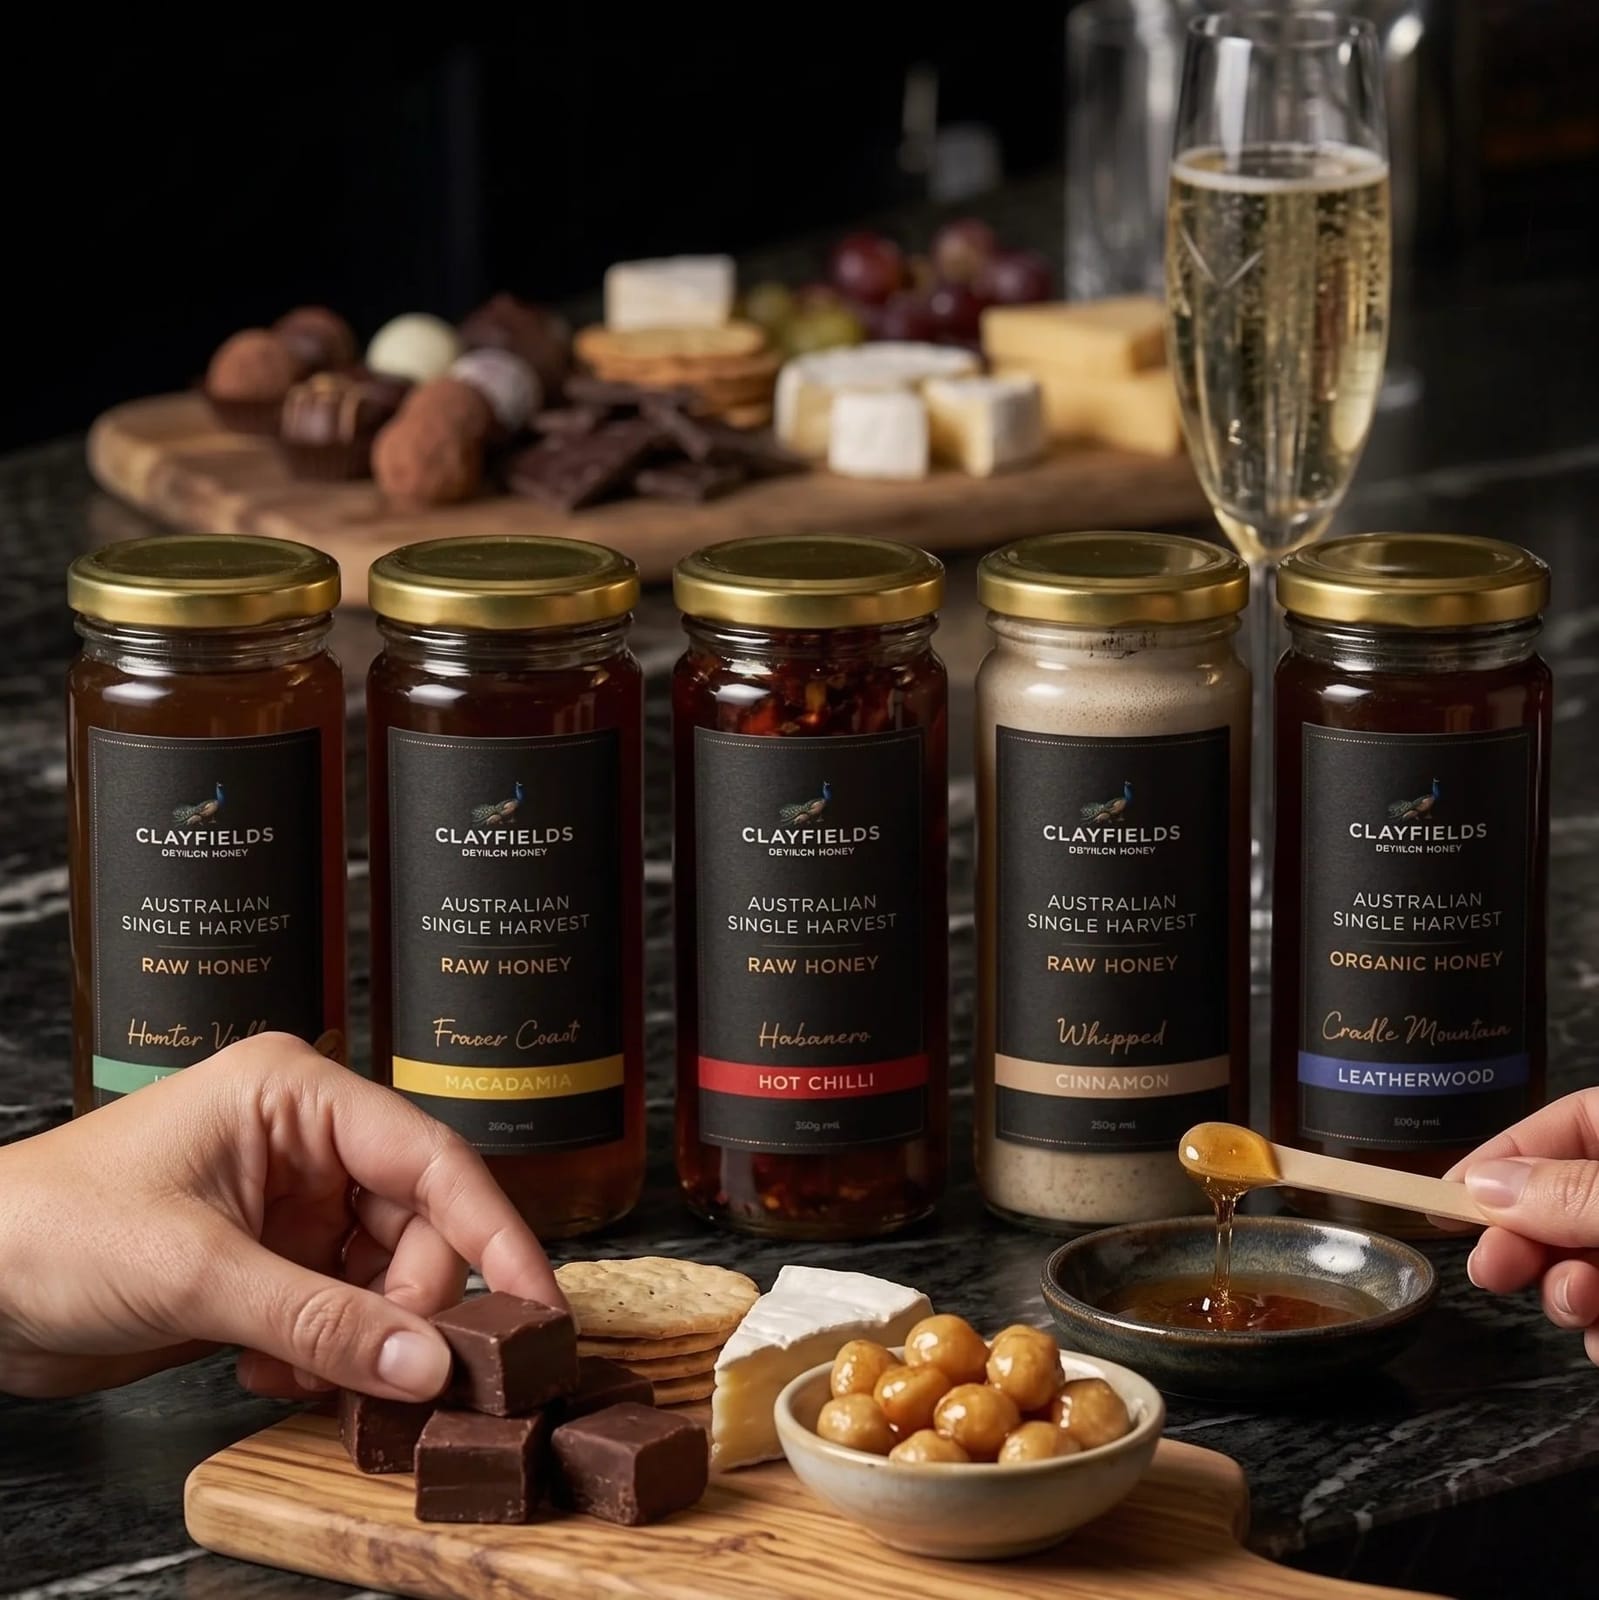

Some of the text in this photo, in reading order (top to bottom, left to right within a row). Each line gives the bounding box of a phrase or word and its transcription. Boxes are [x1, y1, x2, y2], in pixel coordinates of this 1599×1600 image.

[135, 827, 274, 846] CLAYFIELDS
[435, 826, 574, 846] CLAYFIELDS
[742, 825, 881, 845] CLAYFIELDS
[1043, 825, 1181, 844] CLAYFIELDS
[1349, 822, 1488, 841] CLAYFIELDS
[212, 849, 249, 858] HONEY
[511, 848, 548, 857] HONEY
[818, 847, 855, 856] HONEY
[1119, 846, 1156, 856] HONEY
[1426, 844, 1463, 854] HONEY
[140, 896, 270, 914] AUSTRALIAN
[440, 896, 569, 913] AUSTRALIAN
[747, 894, 877, 913] AUSTRALIAN
[1047, 894, 1176, 912] AUSTRALIAN
[1353, 892, 1482, 909] AUSTRALIAN
[121, 914, 291, 936] SINGLE HARVEST
[421, 914, 590, 935] SINGLE HARVEST
[727, 913, 897, 934] SINGLE HARVEST
[1027, 913, 1197, 933] SINGLE HARVEST
[1332, 910, 1503, 932] SINGLE HARVEST
[142, 957, 272, 975] RAW HONEY
[441, 956, 572, 975] RAW HONEY
[748, 955, 879, 975] RAW HONEY
[1047, 955, 1179, 974] RAW HONEY
[1329, 951, 1504, 972] ORGANIC HONEY
[758, 1021, 871, 1049] Habanero
[1057, 1017, 1168, 1055] Whipped
[1322, 1010, 1512, 1046] Cradle Mountain
[445, 1074, 572, 1092] MACADAMIA
[759, 1073, 874, 1090] HOT CHILLI
[1056, 1073, 1169, 1091] CINNAMON
[1338, 1068, 1494, 1088] LEATHERWOOD
